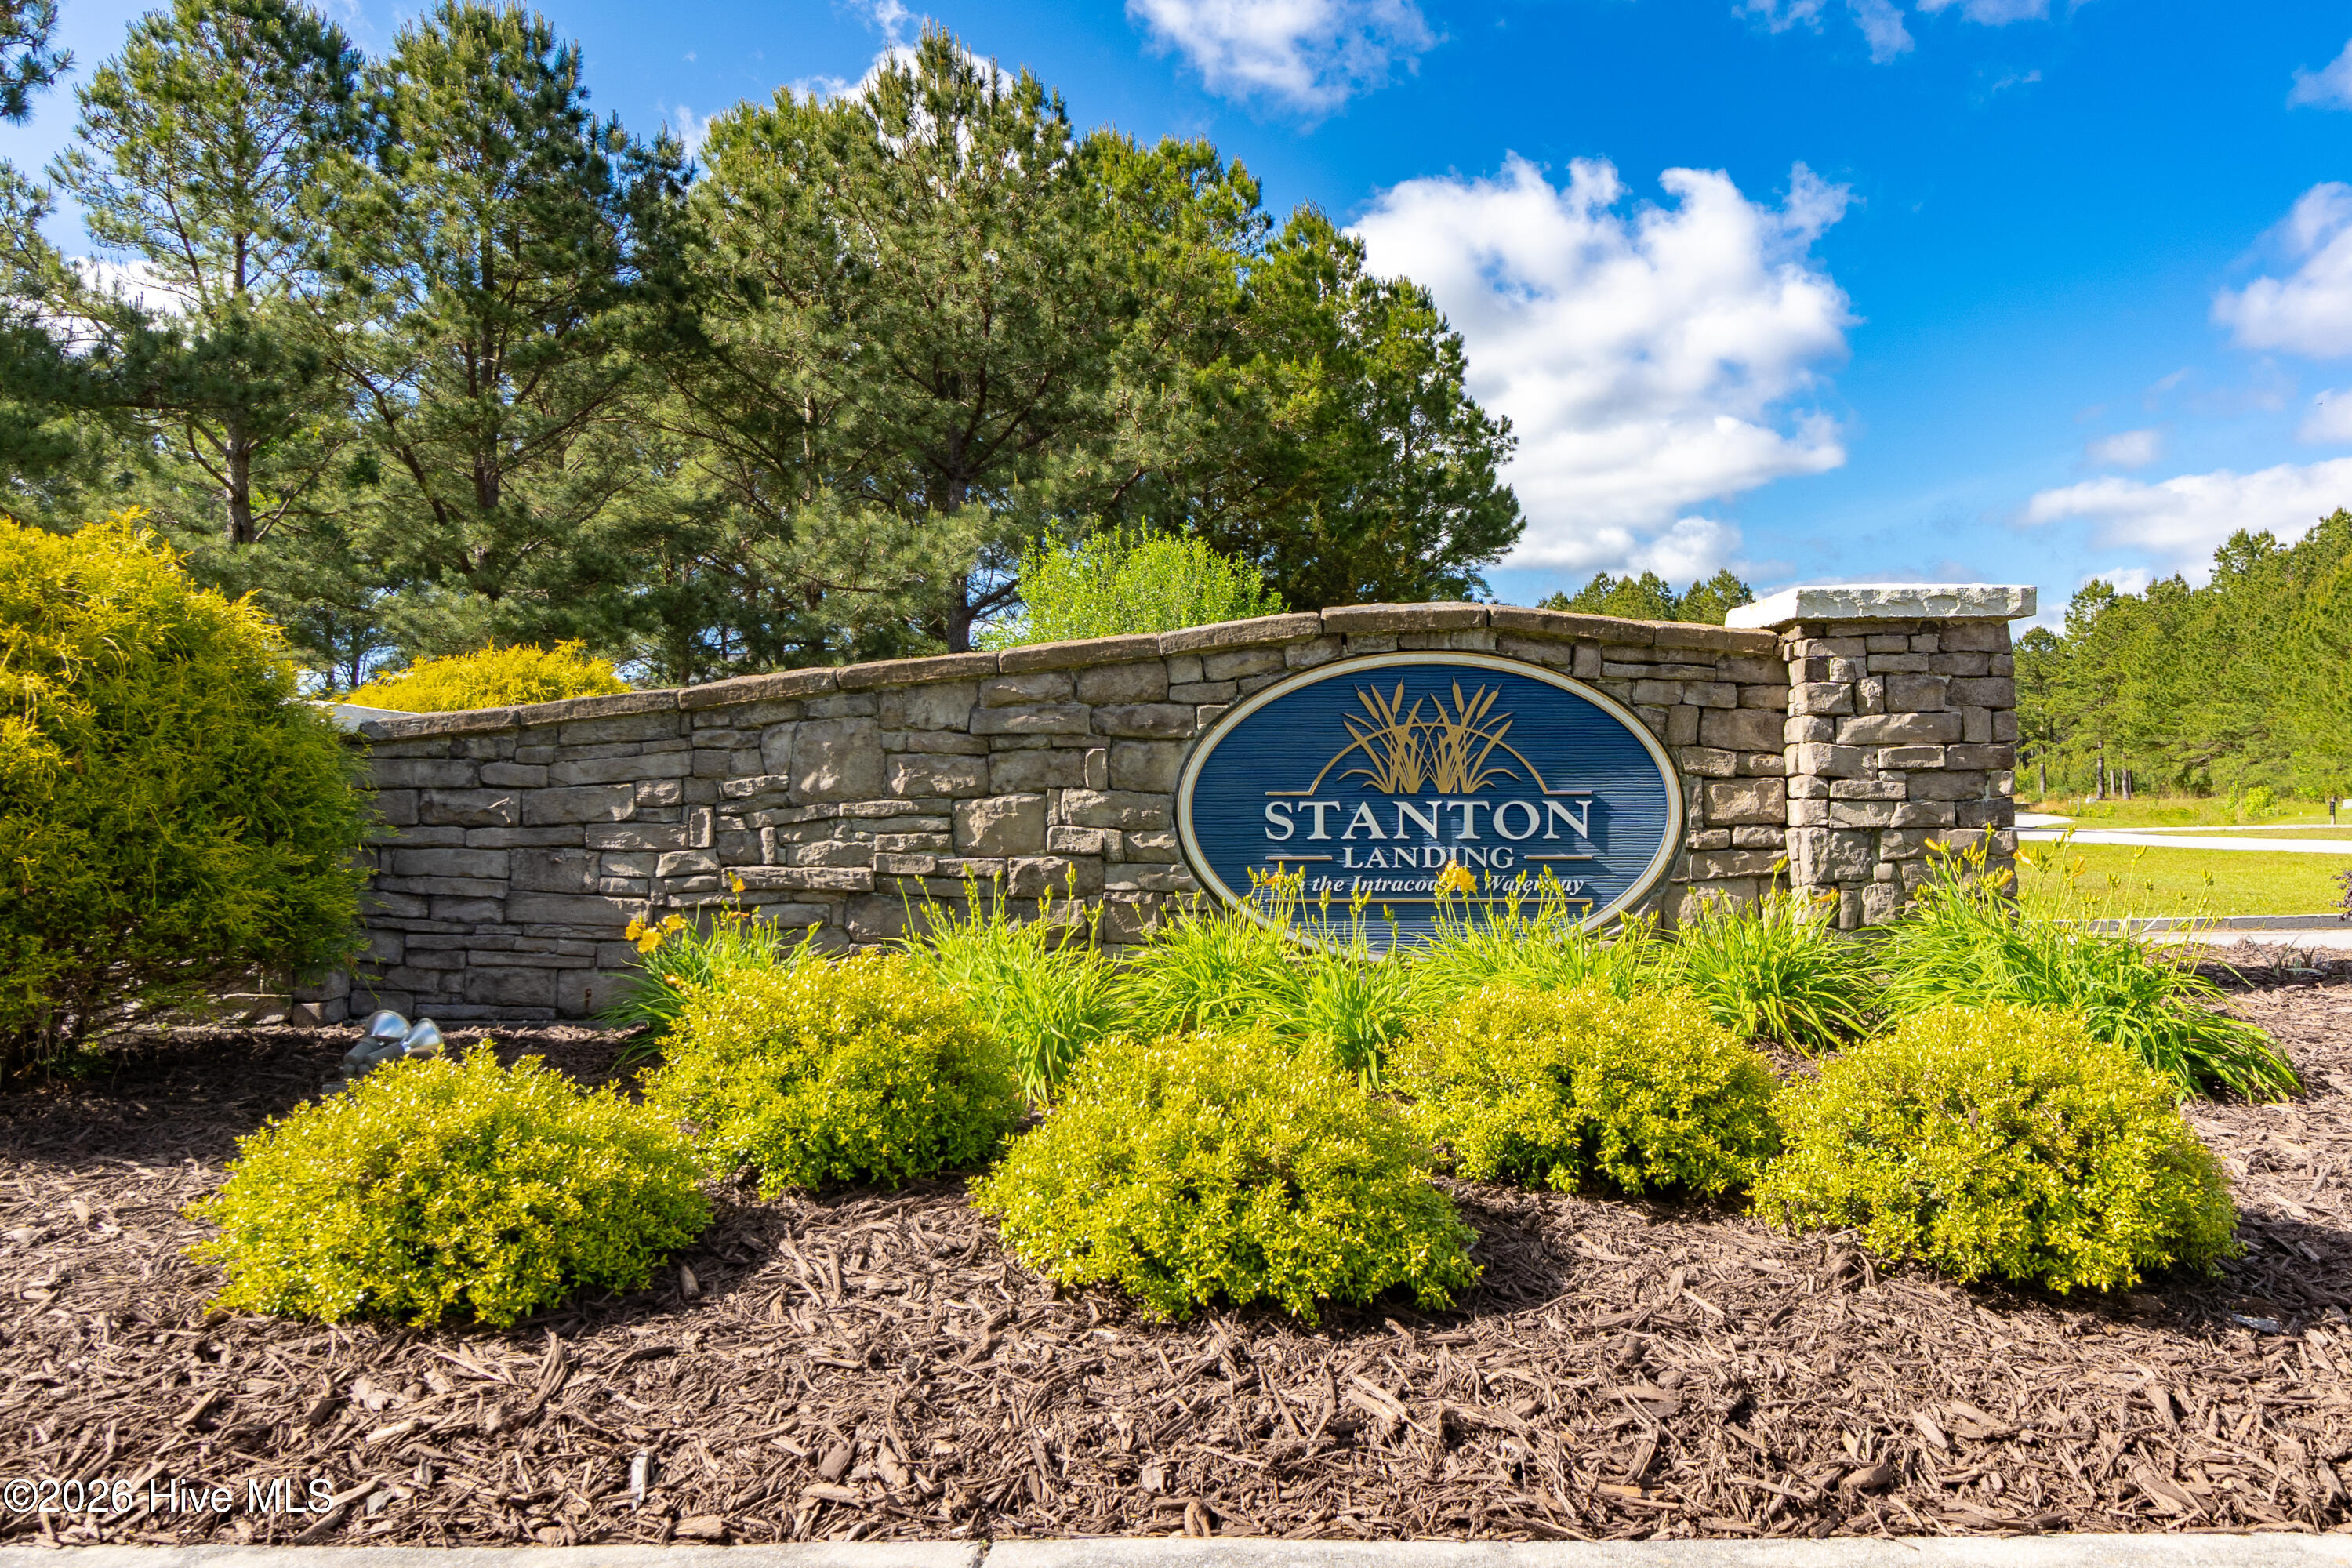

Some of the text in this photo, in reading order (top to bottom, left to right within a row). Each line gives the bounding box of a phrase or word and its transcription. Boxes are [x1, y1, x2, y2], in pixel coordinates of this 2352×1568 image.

[1265, 800, 1592, 840] STANTON
[1343, 846, 1514, 869] LANDING
[1312, 875, 1345, 892] the
[1348, 875, 1477, 892] Intracoa
[1484, 875, 1584, 896] Waeray
